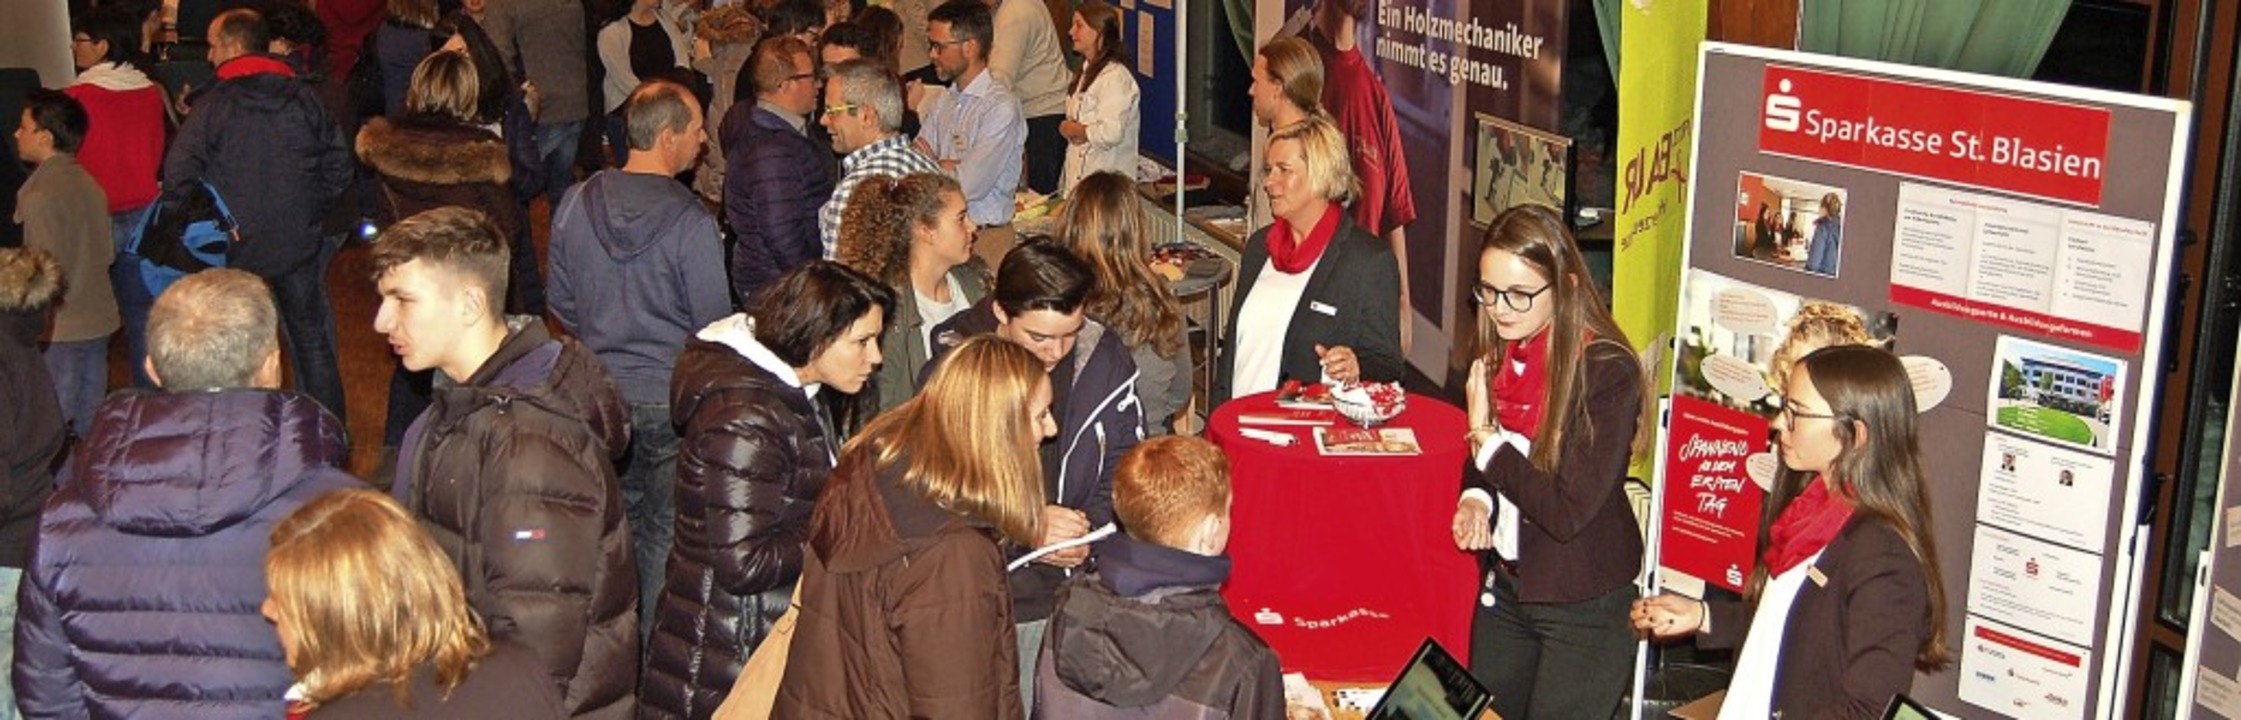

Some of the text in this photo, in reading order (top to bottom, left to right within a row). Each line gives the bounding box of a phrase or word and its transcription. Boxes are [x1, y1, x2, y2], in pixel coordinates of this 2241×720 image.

[1378, 0, 1543, 60] Ein Holzmechaniker
[1376, 33, 1508, 91] nimmt es genau.
[1804, 109, 1943, 154] Sparkasse
[1950, 130, 1985, 162] St.
[1991, 136, 2101, 180] Blasien
[1696, 491, 1728, 519] TAG
